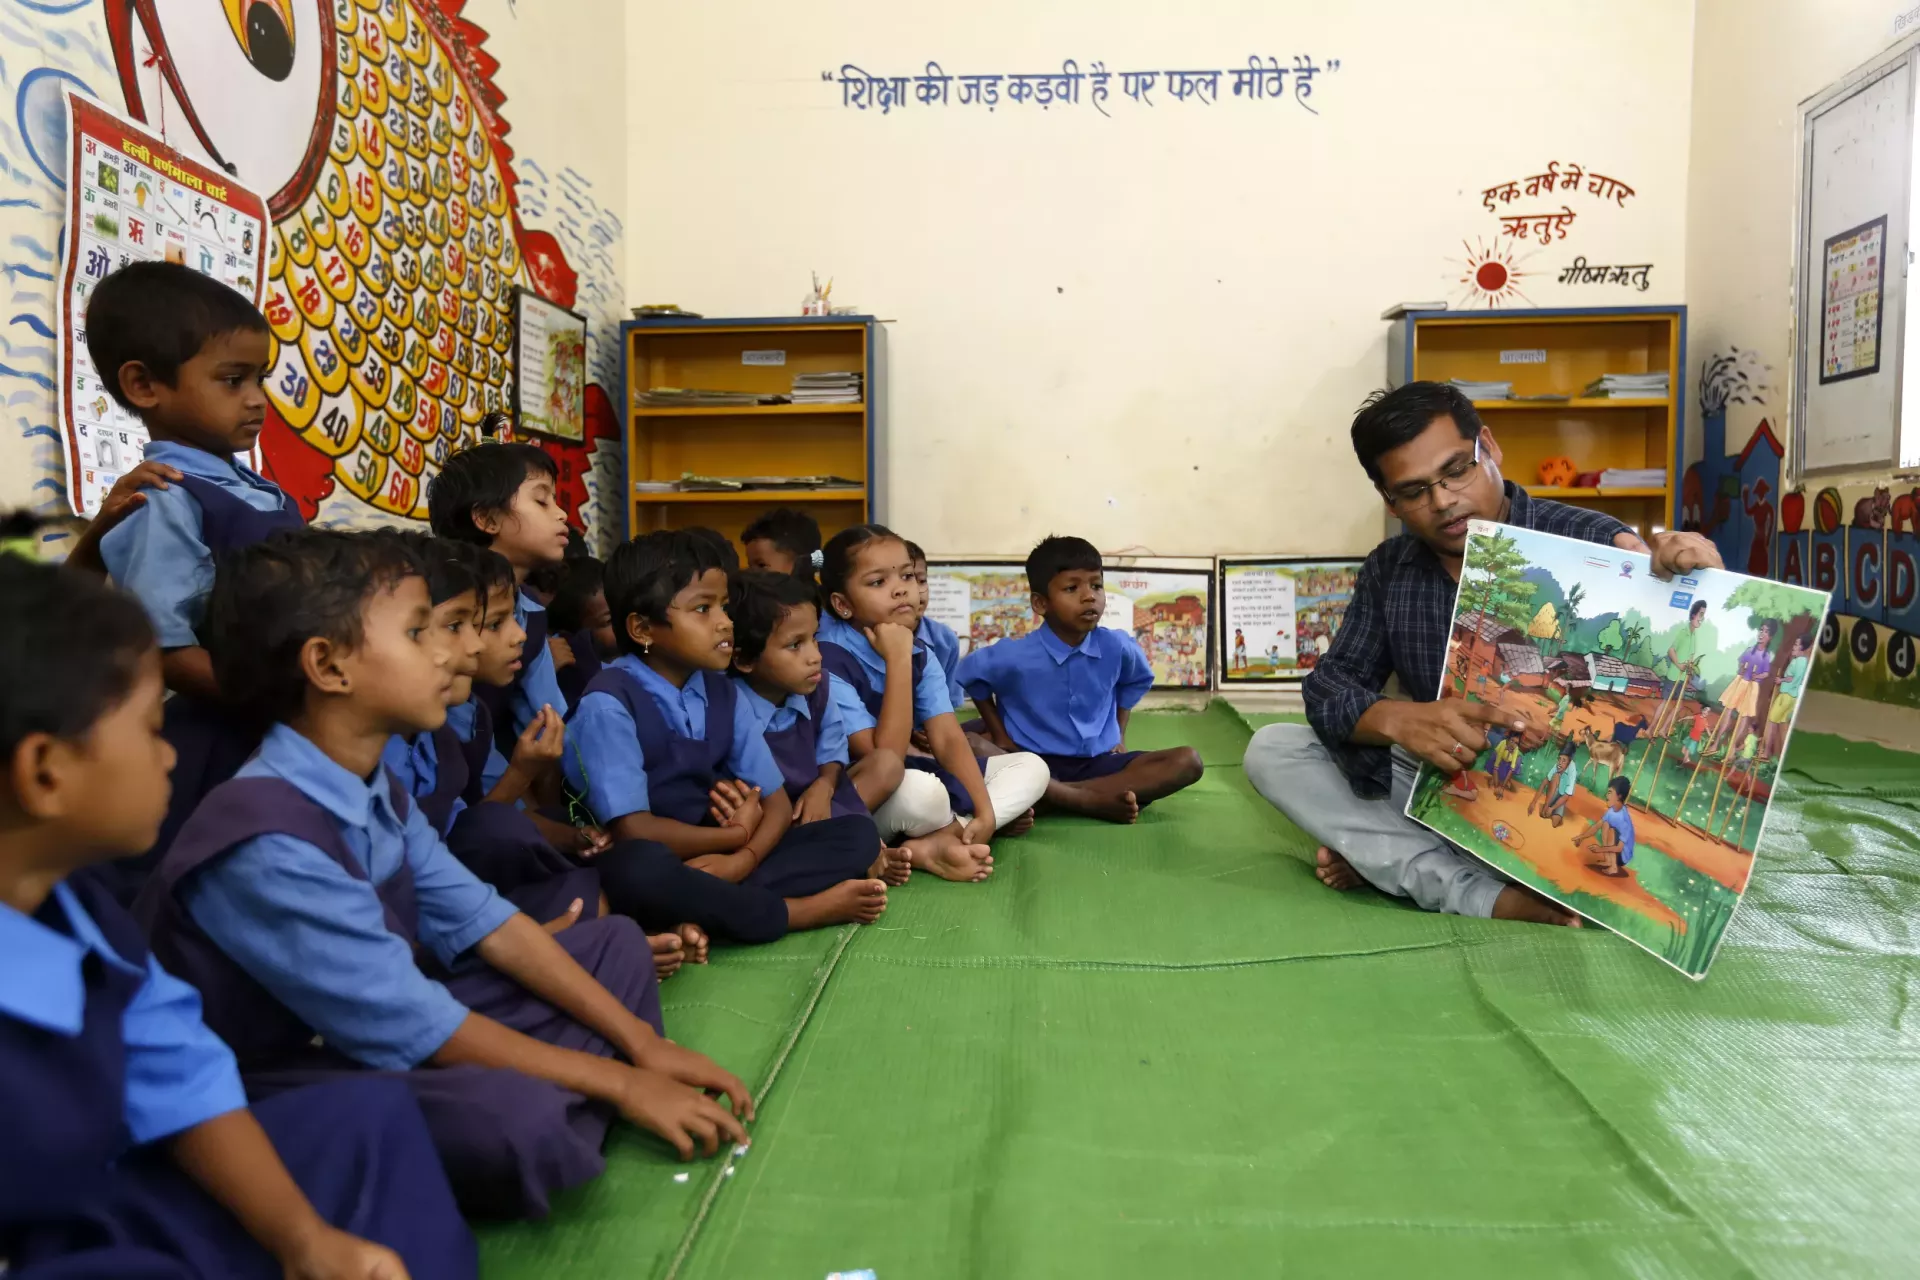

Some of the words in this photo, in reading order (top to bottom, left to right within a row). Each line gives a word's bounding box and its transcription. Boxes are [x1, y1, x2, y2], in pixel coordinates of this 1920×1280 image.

[340, 37, 350, 64] 3
[363, 17, 382, 55] 12
[342, 83, 354, 111] 4
[363, 68, 379, 105] 13
[914, 61, 954, 106] की
[957, 74, 1004, 112] जड़
[1007, 59, 1087, 110] कड़वी
[1088, 60, 1113, 118] है
[1118, 71, 1161, 107] पर
[1163, 70, 1223, 106] फल
[1227, 55, 1290, 100] मीठे
[85, 139, 97, 156] अ
[335, 123, 350, 154] 5
[362, 119, 381, 159] 14
[411, 120, 426, 153] 33
[124, 159, 138, 178] आ
[153, 154, 204, 192] वर्णमाला
[84, 187, 97, 203] ऊ
[327, 173, 341, 205] 6
[356, 171, 375, 212] 15
[1481, 181, 1521, 213] एक
[1524, 161, 1560, 197] वर्ष
[1588, 173, 1636, 209] चार
[128, 216, 146, 246] ऋ
[155, 222, 163, 236] ए
[311, 204, 327, 232] 7
[406, 207, 427, 243] 35
[290, 227, 308, 255] 8
[345, 221, 363, 259] 16
[85, 245, 112, 279] औ
[224, 251, 237, 268] ओ
[325, 255, 347, 288] 17
[400, 251, 418, 286] 36
[264, 292, 293, 327] 19
[297, 275, 321, 315] 18
[357, 291, 378, 325] 27
[389, 287, 408, 320] 37
[443, 288, 460, 320] 55
[340, 317, 362, 355] 28
[381, 324, 400, 358] 38
[314, 339, 339, 379] 29
[405, 339, 425, 373] 47
[280, 361, 309, 409] 30
[363, 356, 386, 396] 39
[392, 379, 415, 415] 48
[322, 406, 349, 449] 40
[369, 414, 392, 452] 49
[417, 397, 437, 434] 58
[354, 449, 378, 493] 50
[402, 438, 421, 473] 59
[388, 470, 412, 512] 60
[1782, 539, 1805, 587] A
[1815, 542, 1838, 592] B
[1855, 542, 1880, 608] C
[1889, 549, 1918, 615] D
[1857, 632, 1868, 653] c
[1895, 636, 1908, 669] d
